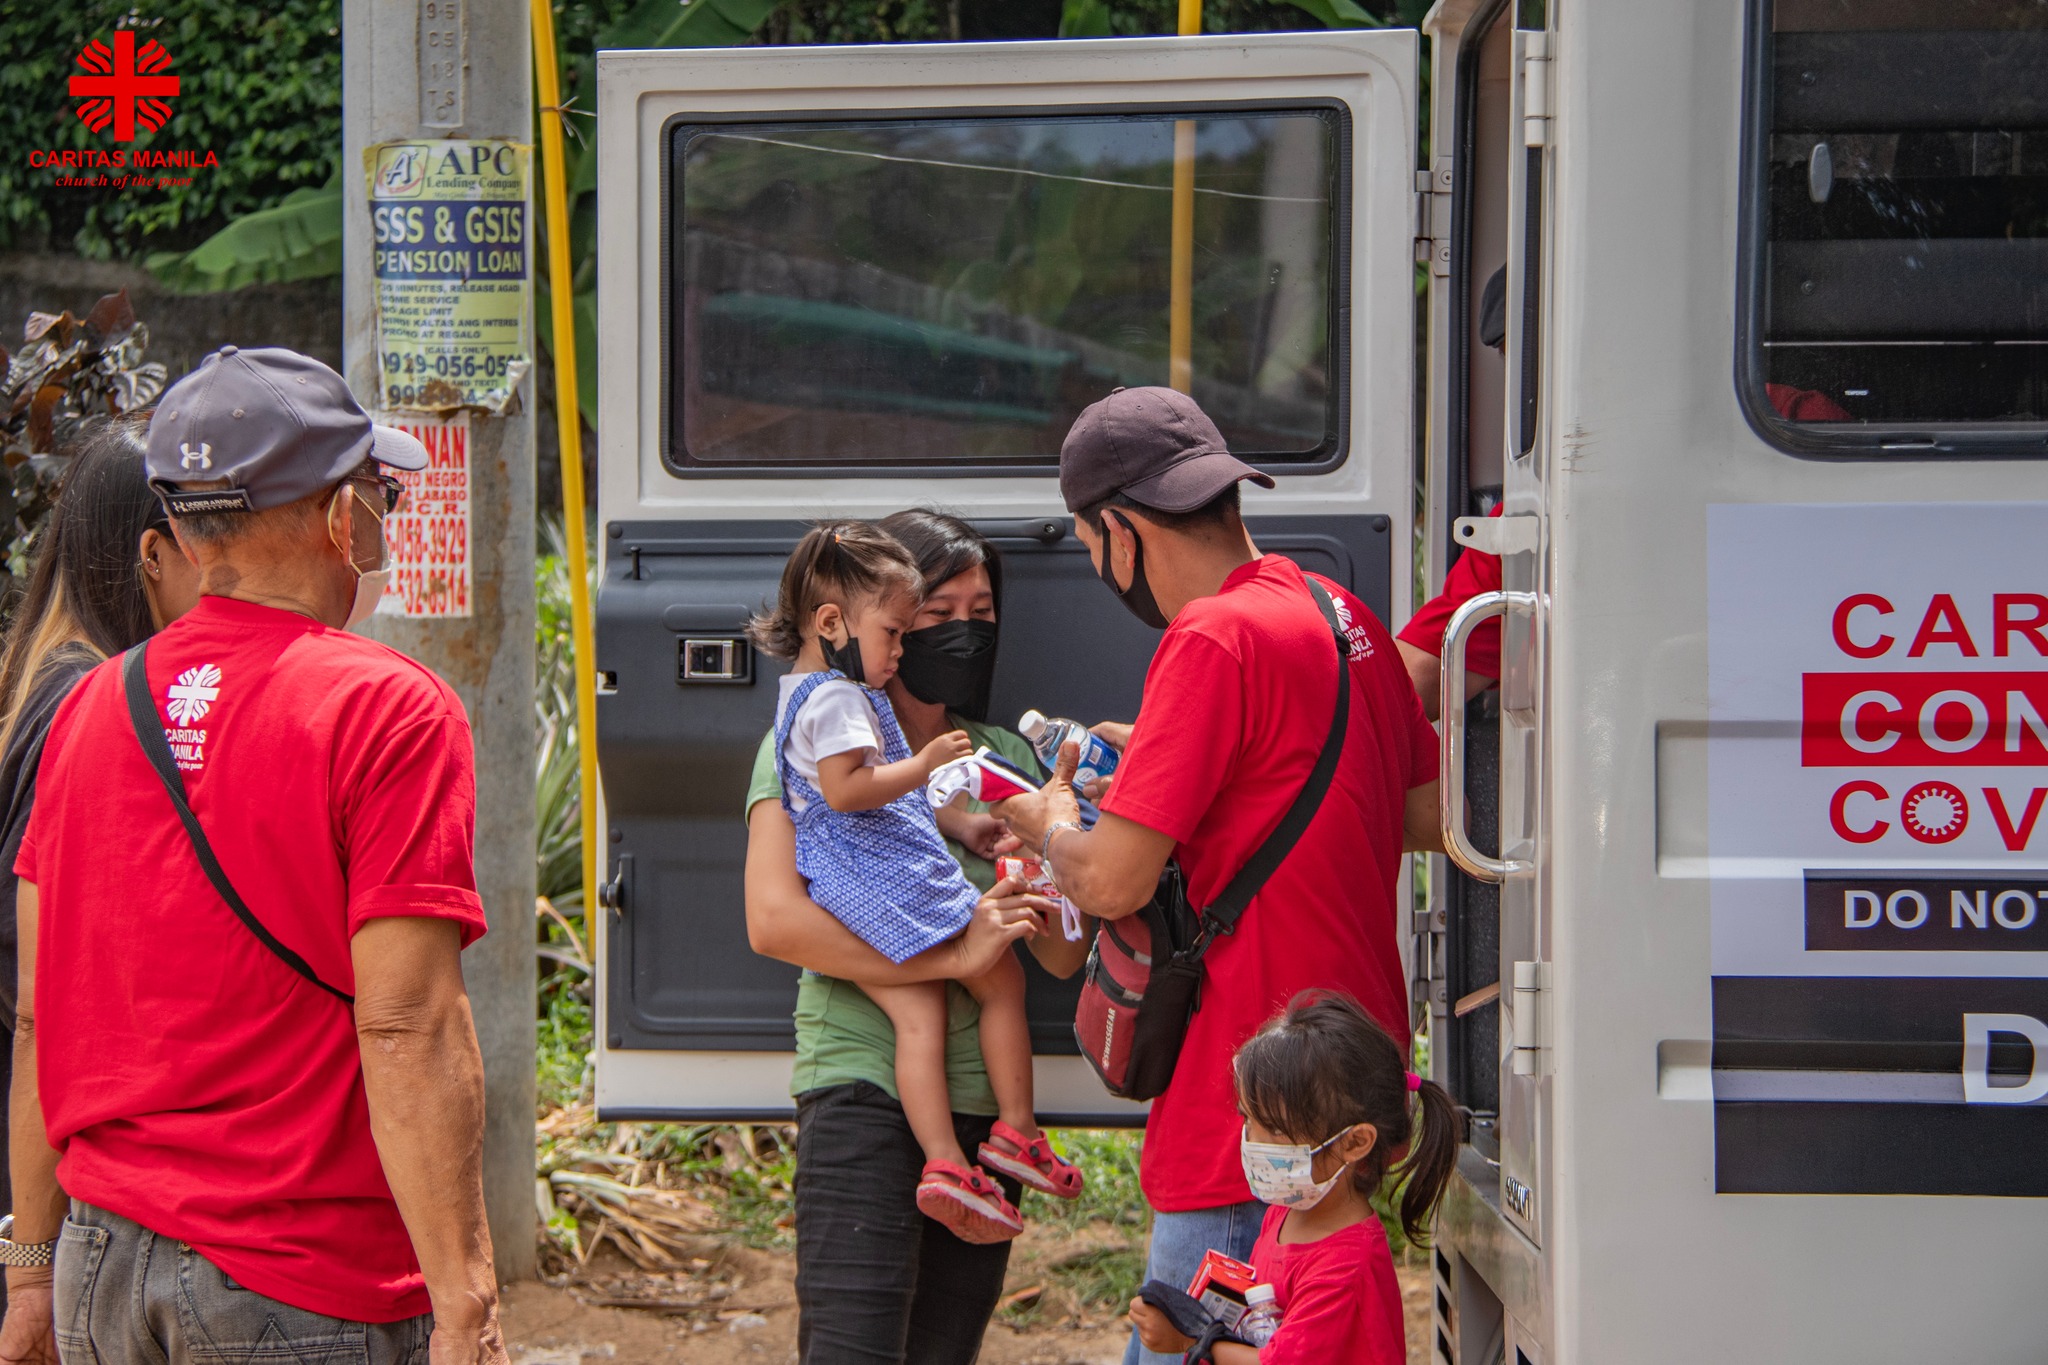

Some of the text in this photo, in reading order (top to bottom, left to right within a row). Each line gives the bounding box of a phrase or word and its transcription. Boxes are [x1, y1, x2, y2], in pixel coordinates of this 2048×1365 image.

[435, 145, 515, 176] APC
[427, 177, 476, 189] Lending
[374, 205, 523, 244] SSS & GSIS
[375, 250, 523, 274] PENSION LOAN
[413, 296, 460, 304] SERVICE
[398, 307, 420, 315] AGE
[423, 307, 453, 316] LIMIT
[413, 319, 455, 327] KALTAS
[457, 319, 480, 327] ANG
[438, 330, 482, 339] REGALO
[425, 471, 467, 487] NEGRO
[415, 490, 467, 501] LABABO
[1832, 593, 2048, 659] CAR
[1839, 689, 2048, 754] CON
[165, 728, 207, 744] CARITAS
[1844, 889, 2048, 930] DO NO
[1103, 1008, 1116, 1060] SWISSGEAR
[1963, 1013, 2048, 1104] D
